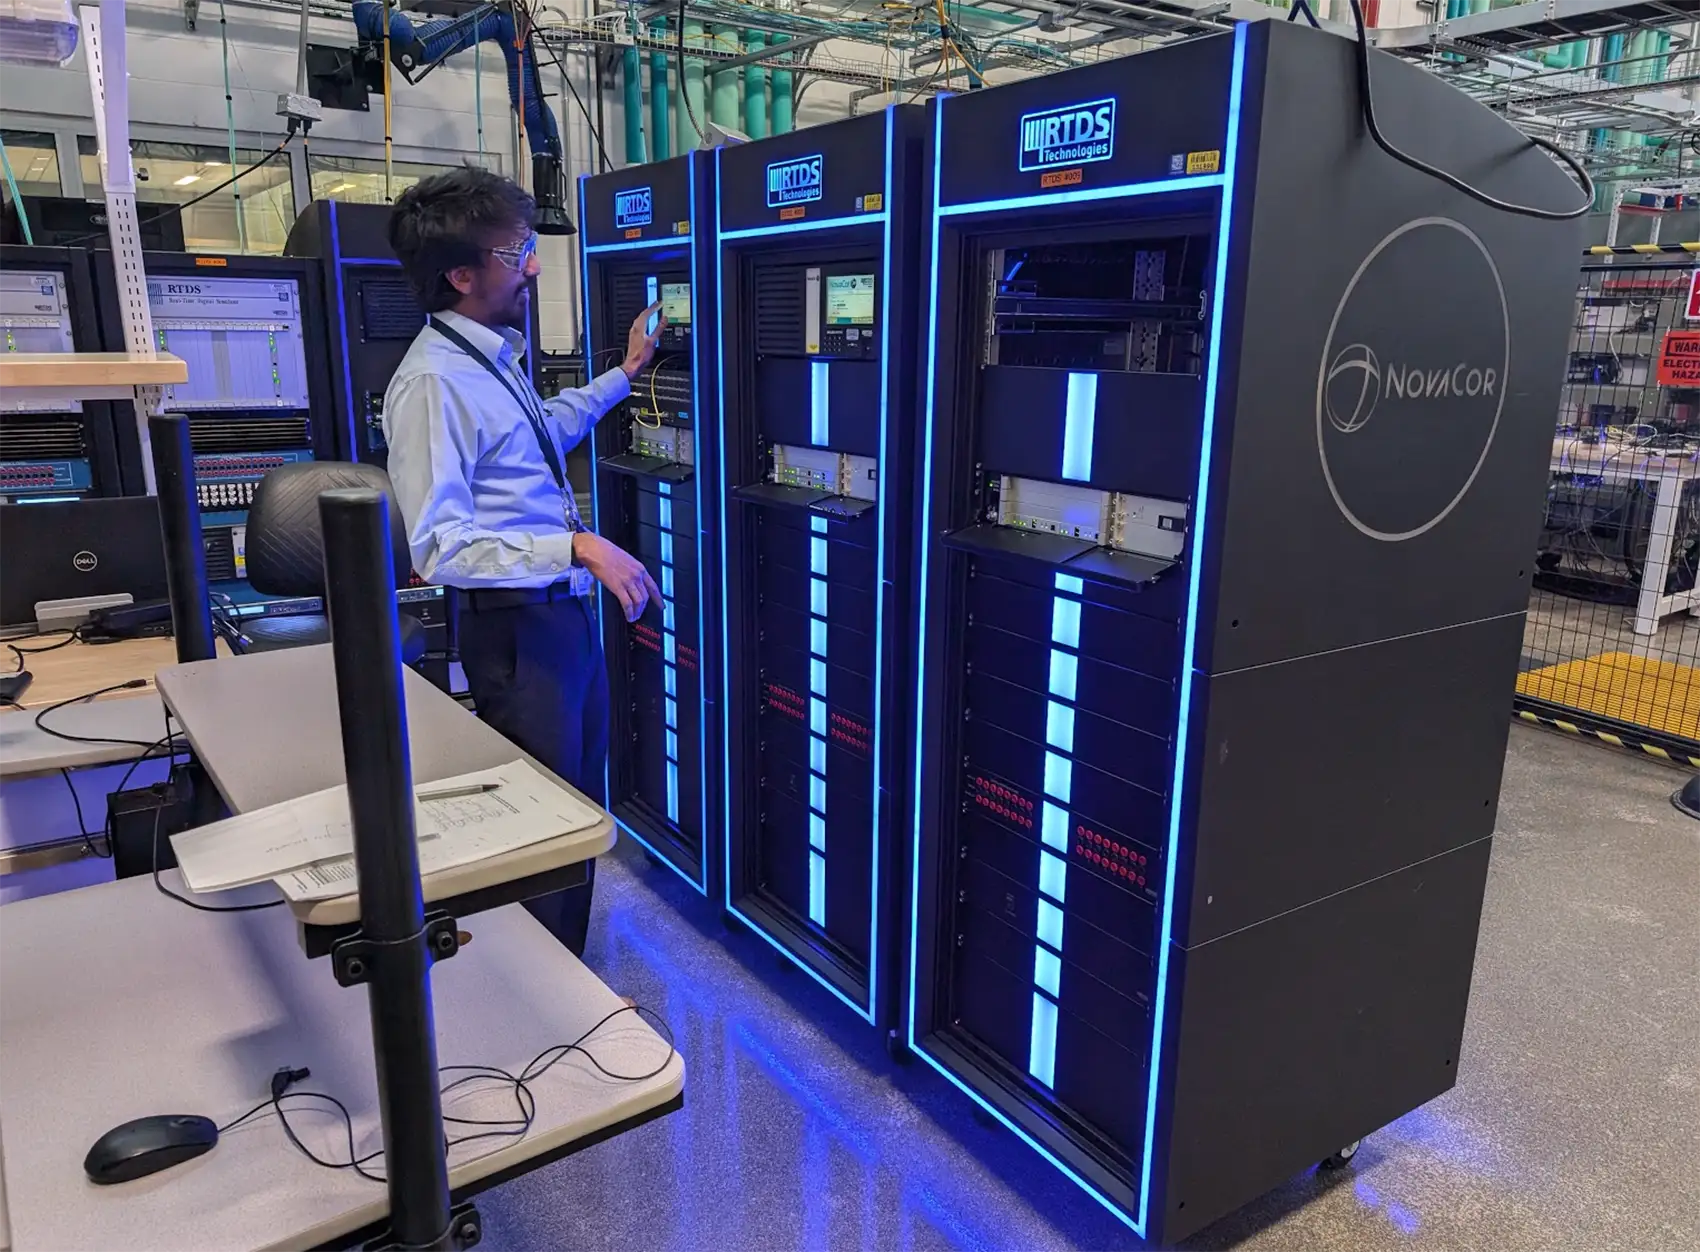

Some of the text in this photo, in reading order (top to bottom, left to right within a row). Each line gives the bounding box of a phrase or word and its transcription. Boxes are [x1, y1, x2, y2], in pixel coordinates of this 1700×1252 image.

[1045, 107, 1110, 147] RTDS
[1044, 142, 1109, 162] Technologies
[782, 160, 820, 190] RTDS
[625, 192, 650, 213] RTDS
[782, 187, 819, 201] Technologies
[167, 284, 202, 294] RTDS
[1675, 342, 1700, 352] WAR
[1664, 359, 1700, 368] ELECT
